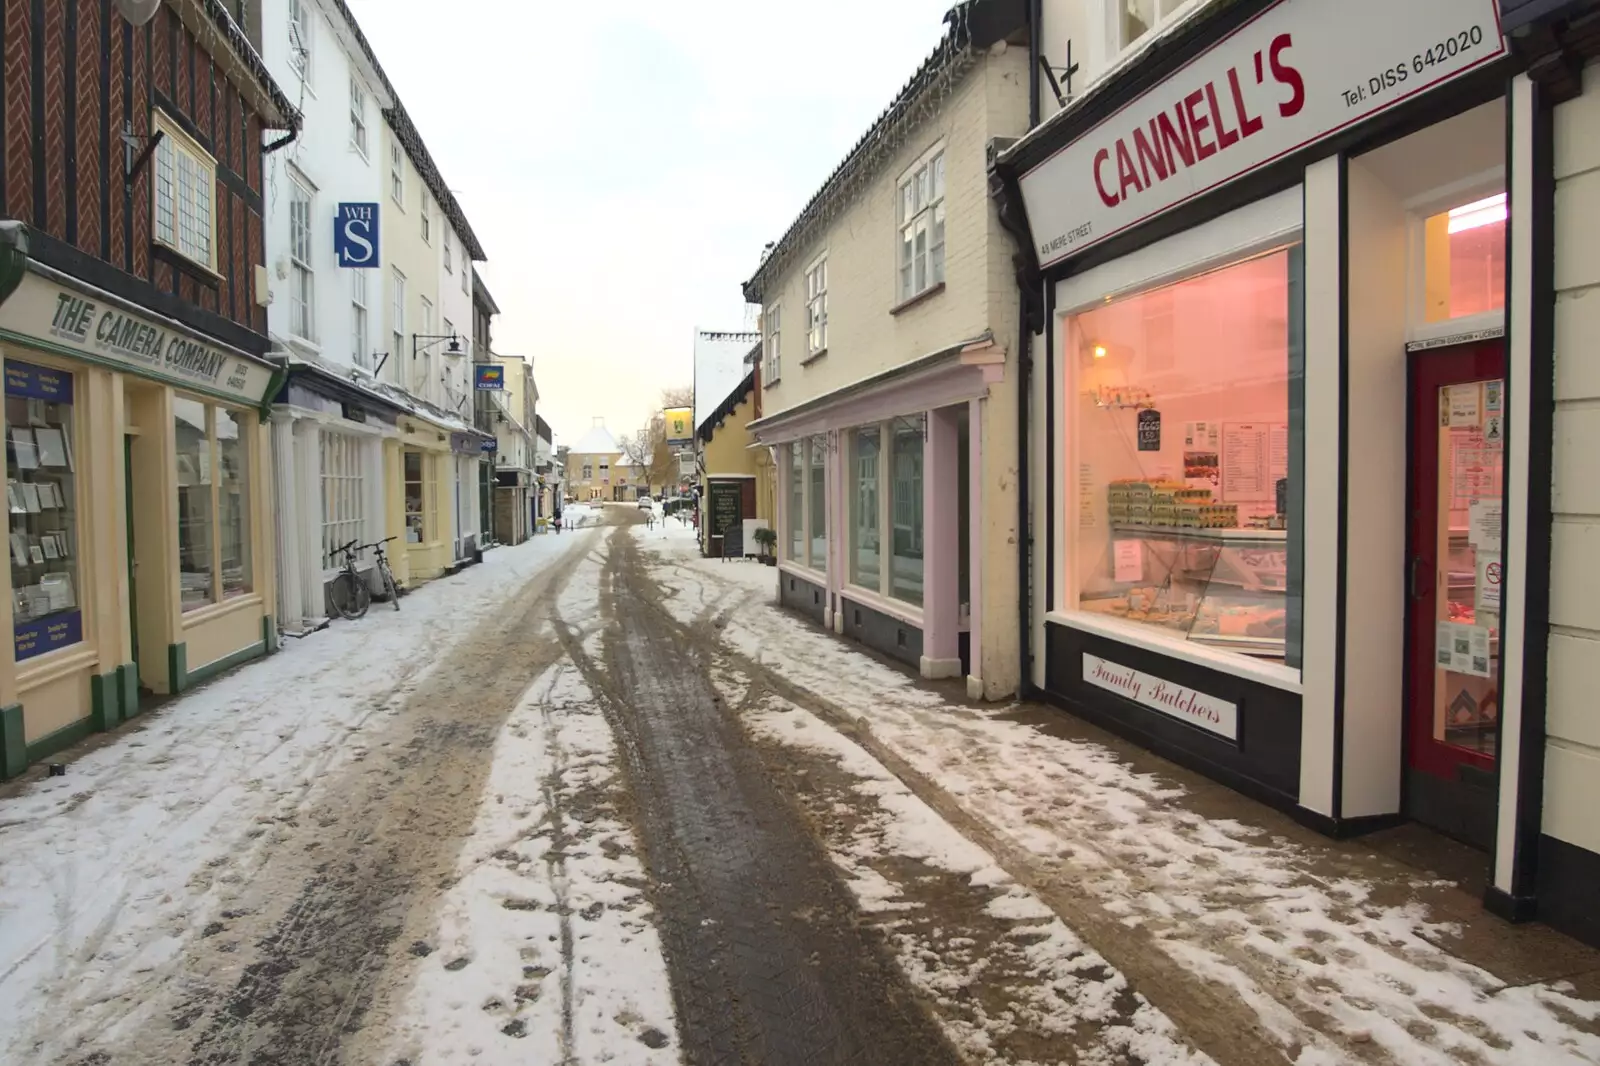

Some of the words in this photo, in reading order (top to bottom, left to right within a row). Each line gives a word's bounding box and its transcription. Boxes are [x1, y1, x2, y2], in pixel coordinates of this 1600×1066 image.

[1341, 86, 1367, 108] Tel:
[1369, 63, 1408, 96] DISS
[1412, 25, 1483, 74] 642020
[1093, 33, 1305, 208] CANNELL'S
[344, 219, 373, 263] S
[345, 206, 372, 220] WH
[1067, 221, 1092, 243] STREET
[51, 292, 95, 336] THE
[96, 311, 165, 360] CAMERA
[165, 337, 228, 379] COMPANY
[1091, 660, 1142, 700] Family
[1148, 682, 1221, 725] Butchers
